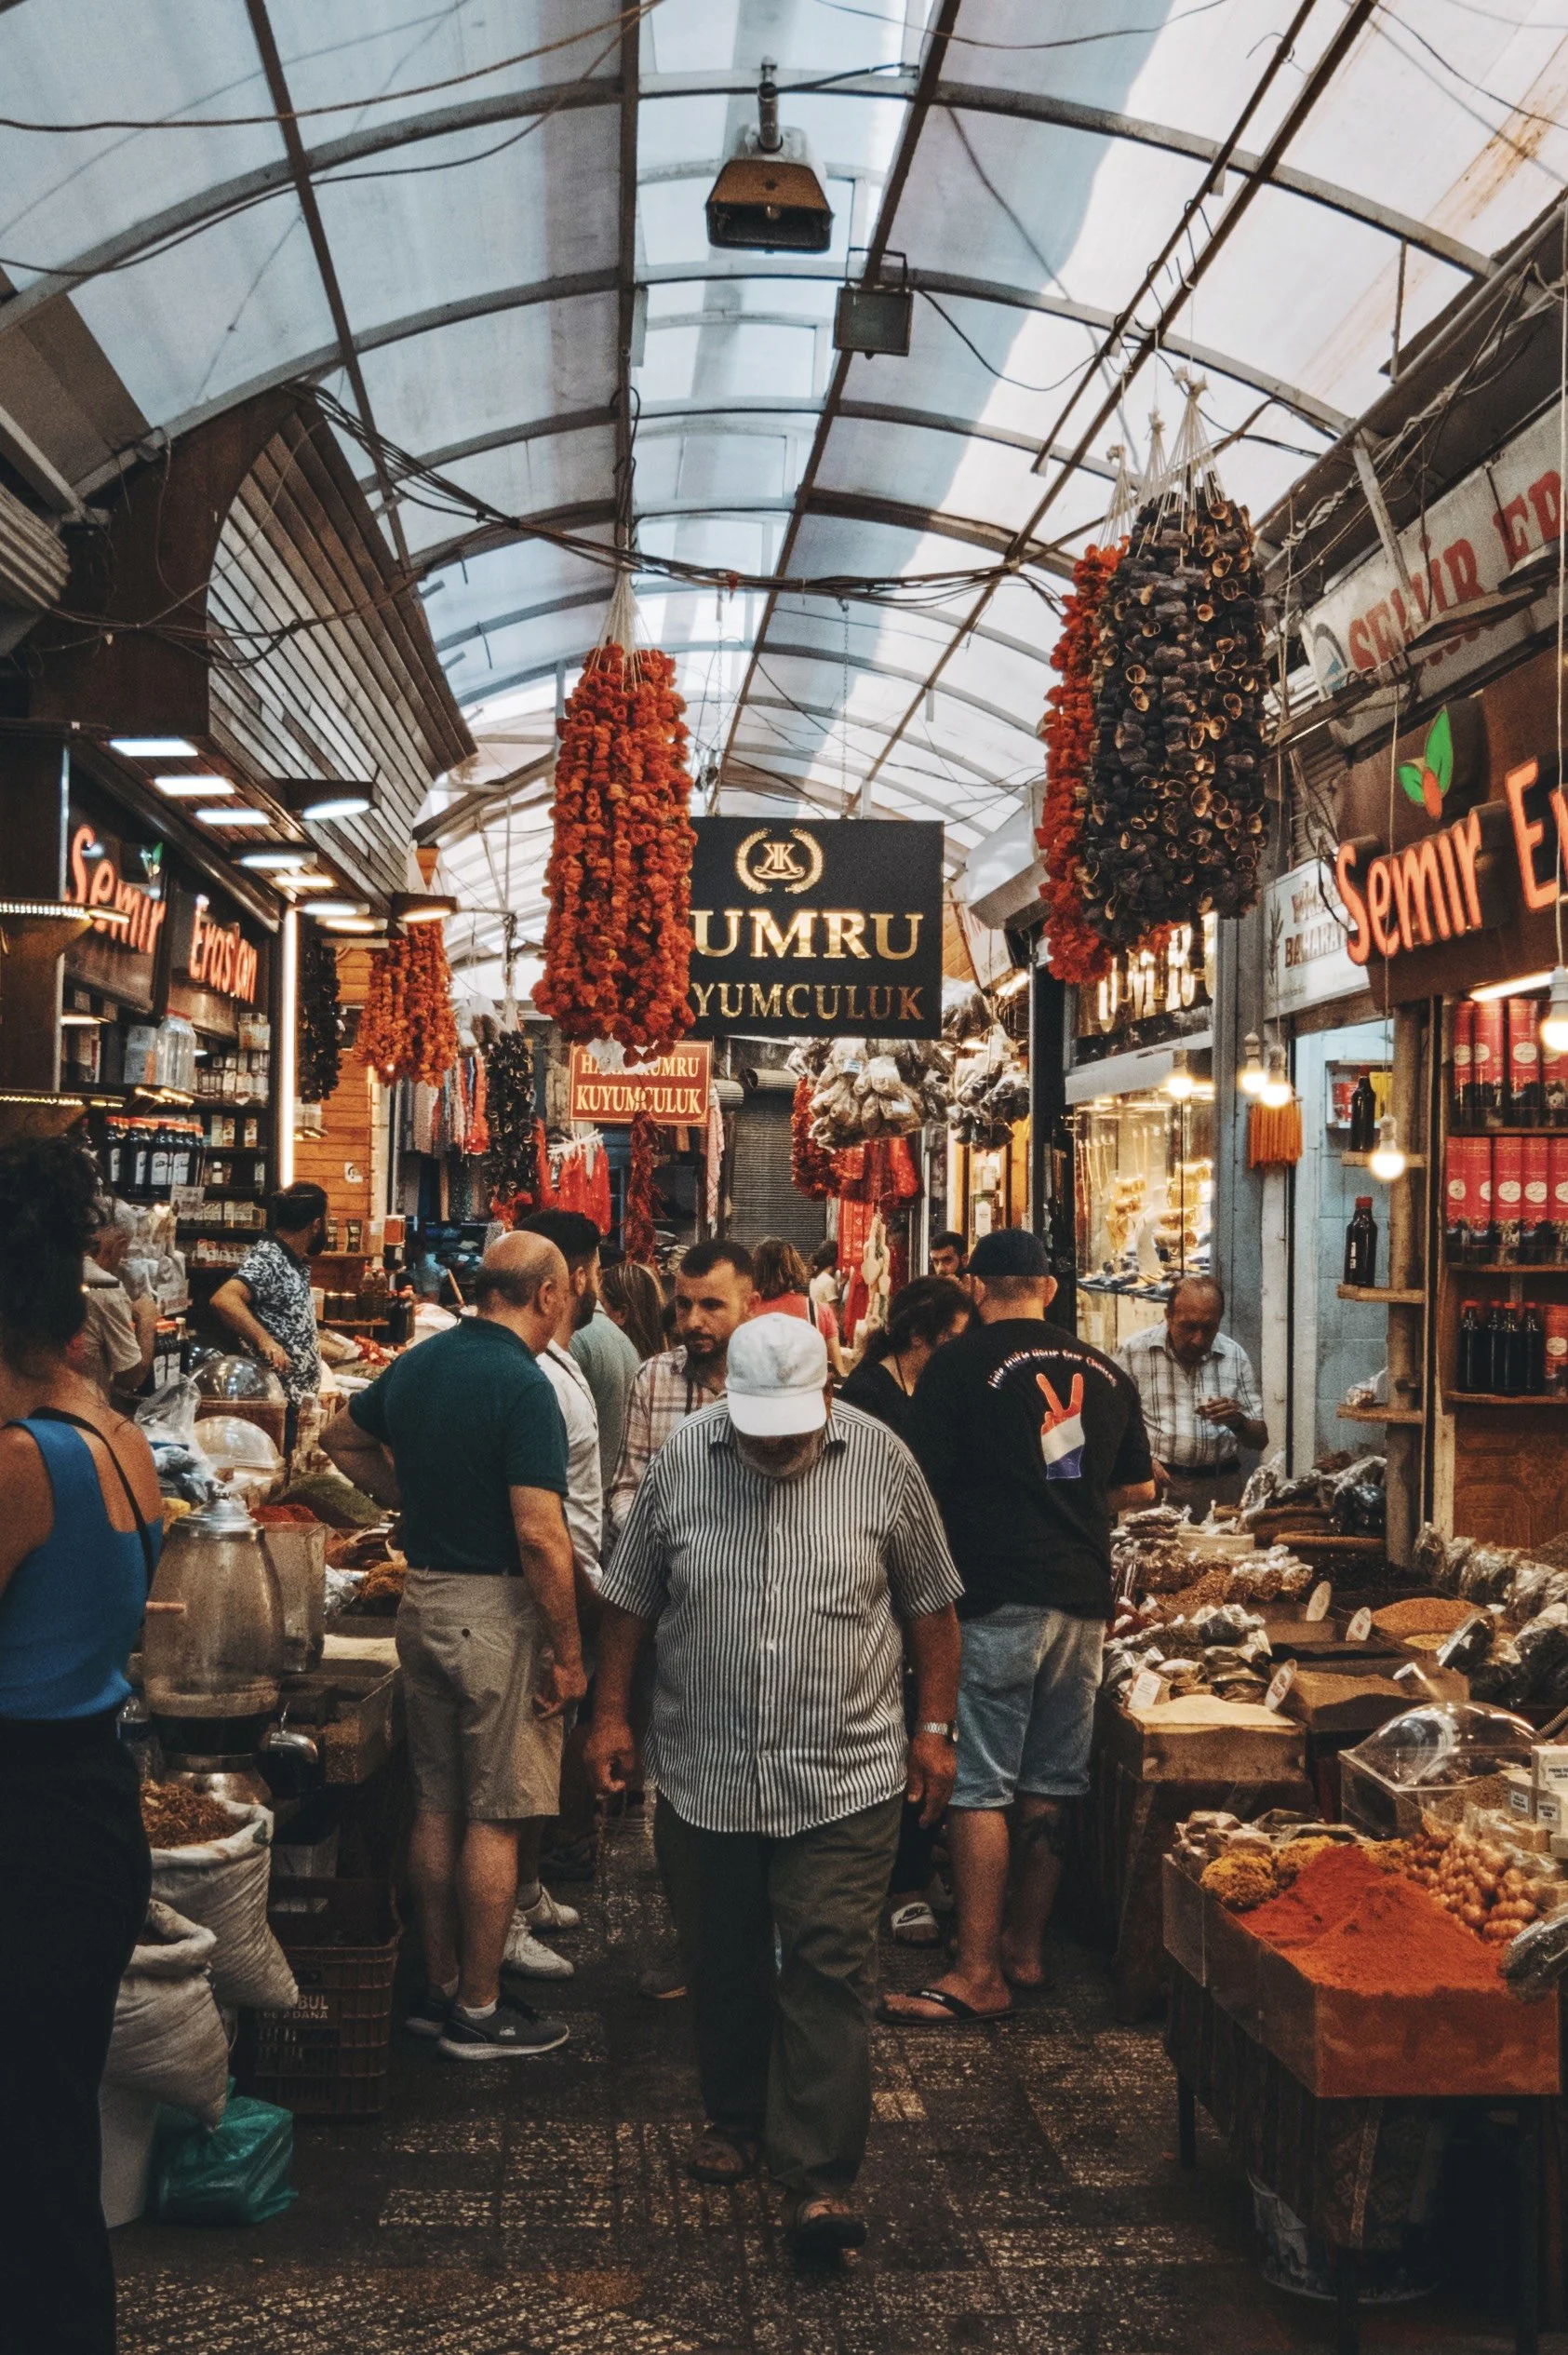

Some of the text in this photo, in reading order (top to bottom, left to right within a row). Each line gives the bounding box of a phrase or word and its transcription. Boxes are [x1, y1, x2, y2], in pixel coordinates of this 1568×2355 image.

[690, 908, 924, 961] UMRU
[690, 983, 925, 1020] YUMCULUK
[576, 1084, 702, 1114] KUYUMCULUK
[297, 1994, 329, 2010] BUL
